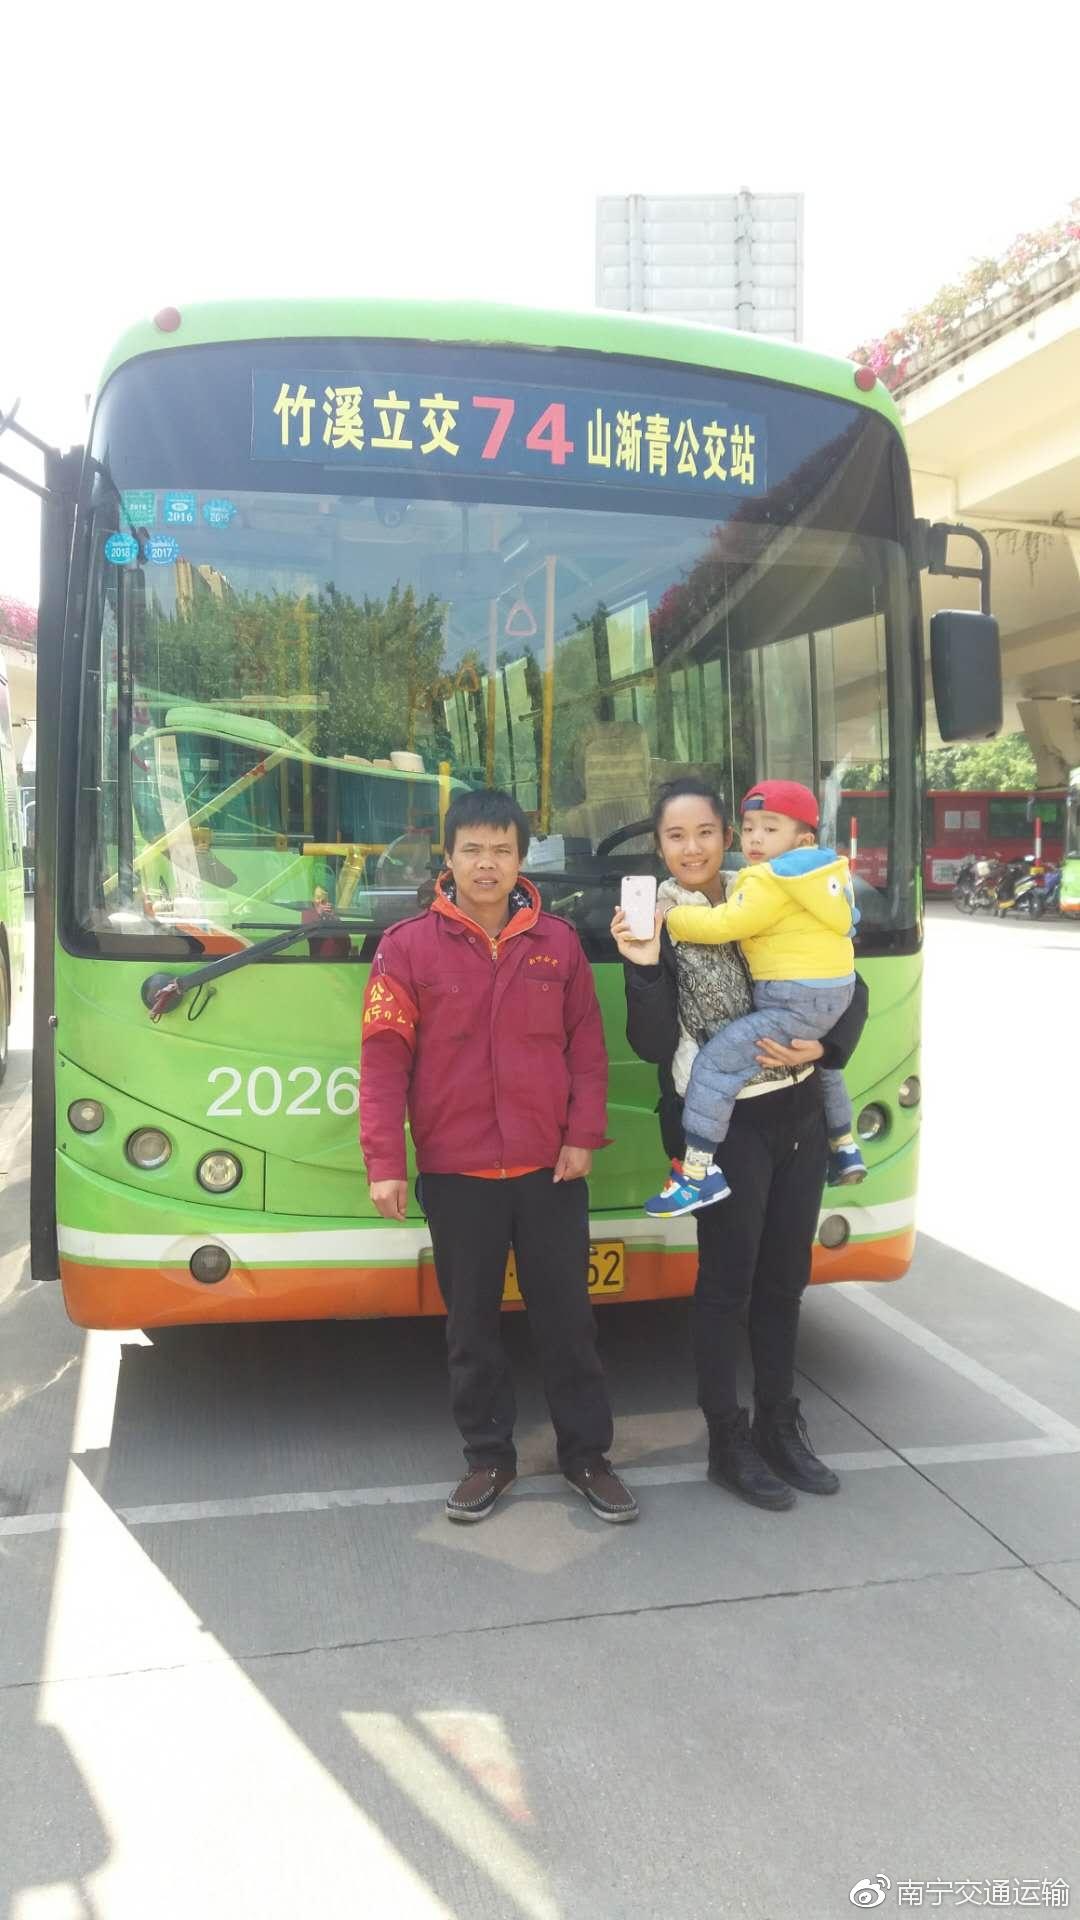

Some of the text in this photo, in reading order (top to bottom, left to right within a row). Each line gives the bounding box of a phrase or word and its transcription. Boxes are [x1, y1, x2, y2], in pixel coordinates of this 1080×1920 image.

[273, 382, 755, 485] 竹溪立交 74 山渐青公交站
[167, 511, 193, 522] 2016
[151, 547, 172, 558] 2017
[206, 1065, 361, 1117] 2026
